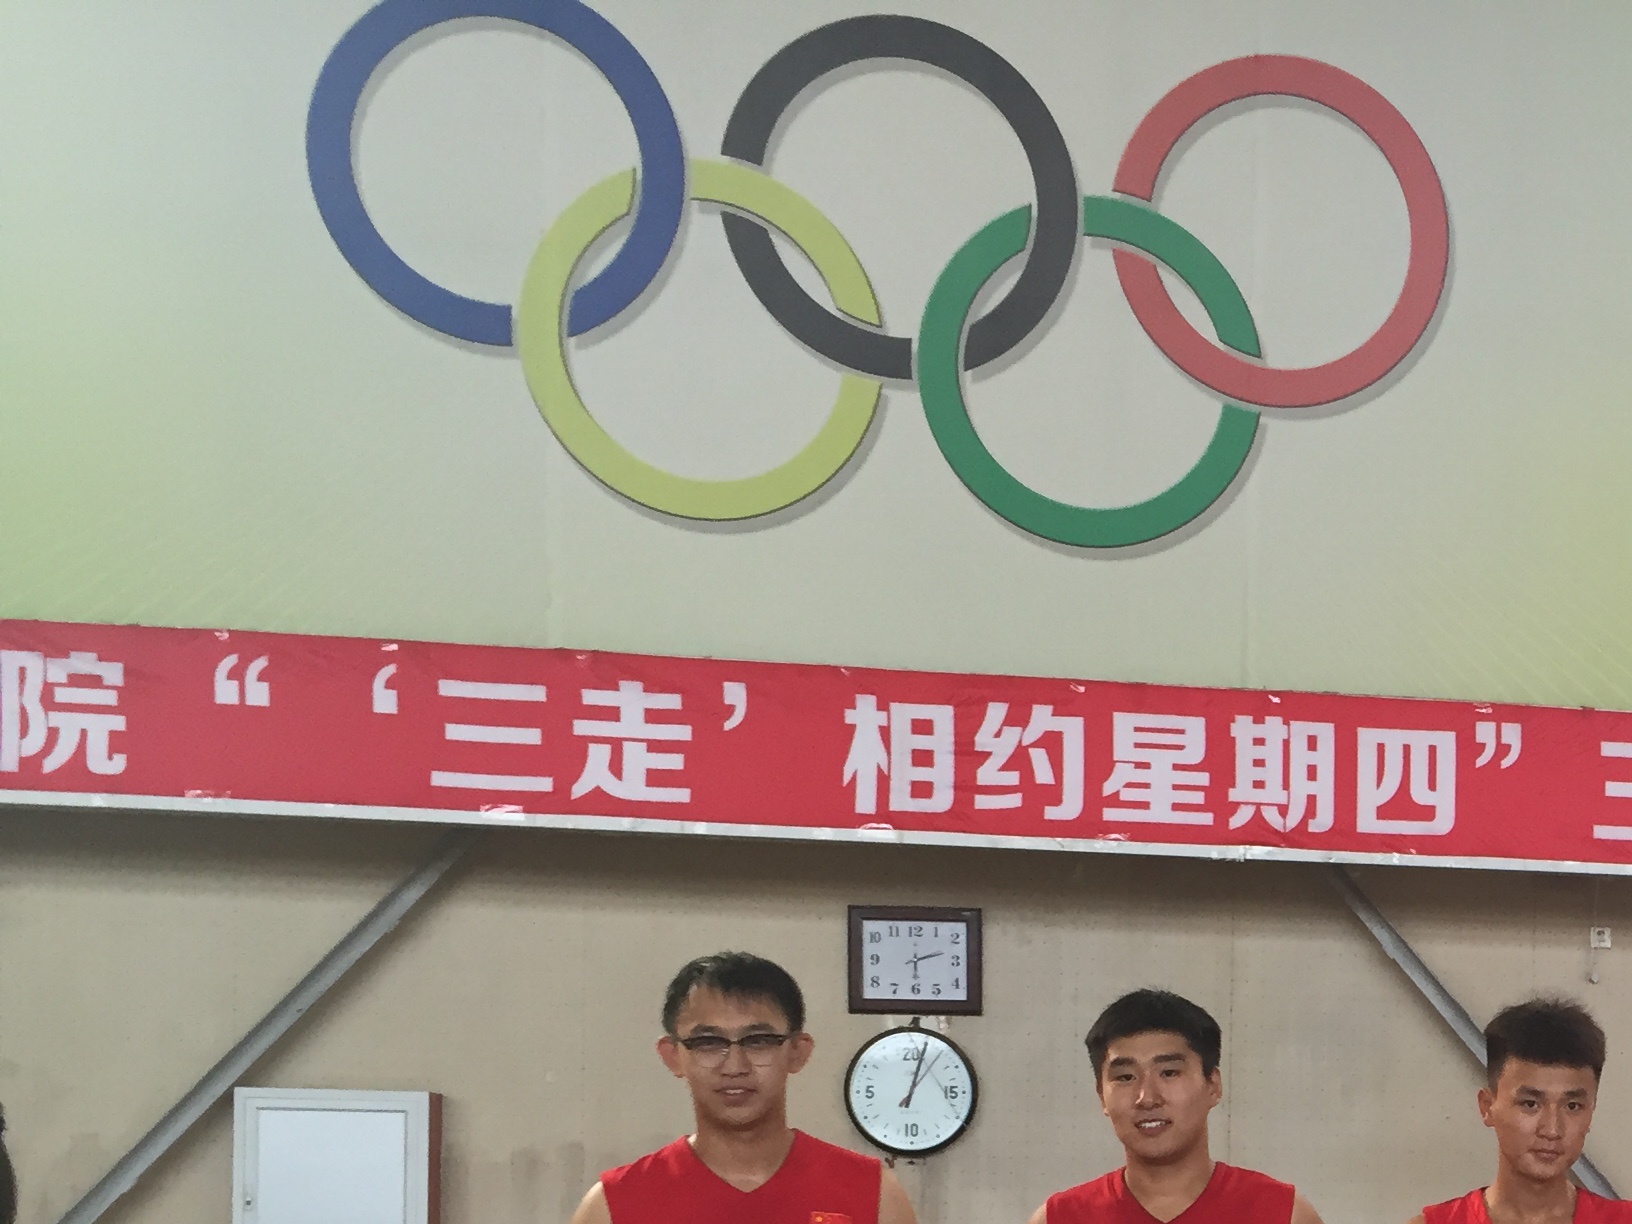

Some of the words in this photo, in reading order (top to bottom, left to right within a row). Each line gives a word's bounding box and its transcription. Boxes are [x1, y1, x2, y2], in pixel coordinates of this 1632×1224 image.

[869, 931, 881, 943] 10
[908, 925, 924, 938] 12
[933, 926, 939, 938] 1
[950, 932, 960, 944] 2
[870, 953, 880, 966] 9
[951, 954, 961, 967] 3
[870, 975, 880, 988] 8
[951, 977, 961, 990] 4
[889, 982, 899, 995] 7
[911, 983, 921, 995] 6
[931, 983, 942, 996] 5
[903, 1046, 920, 1061] 20
[865, 1085, 875, 1099] 5
[943, 1085, 959, 1099] 15
[904, 1123, 919, 1137] 10
